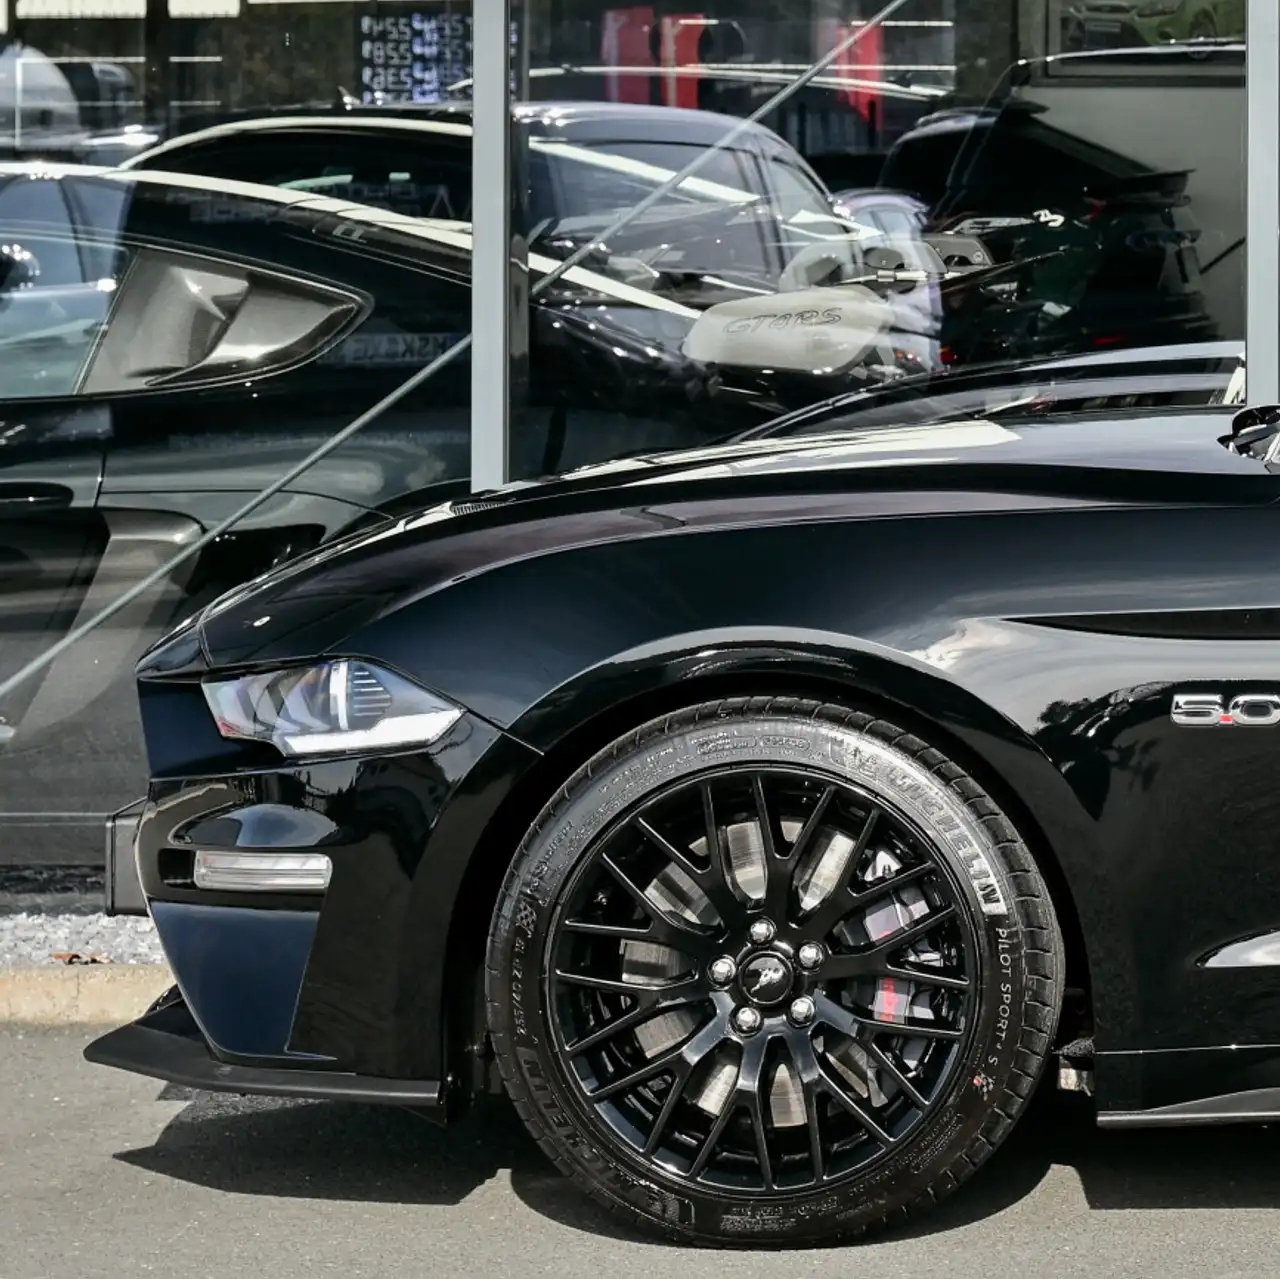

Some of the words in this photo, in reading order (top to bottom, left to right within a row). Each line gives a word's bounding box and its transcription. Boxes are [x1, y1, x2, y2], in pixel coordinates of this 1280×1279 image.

[887, 767, 1001, 904] MICHELIN
[995, 927, 1013, 977] PILOT
[995, 982, 1012, 1041] SPORT
